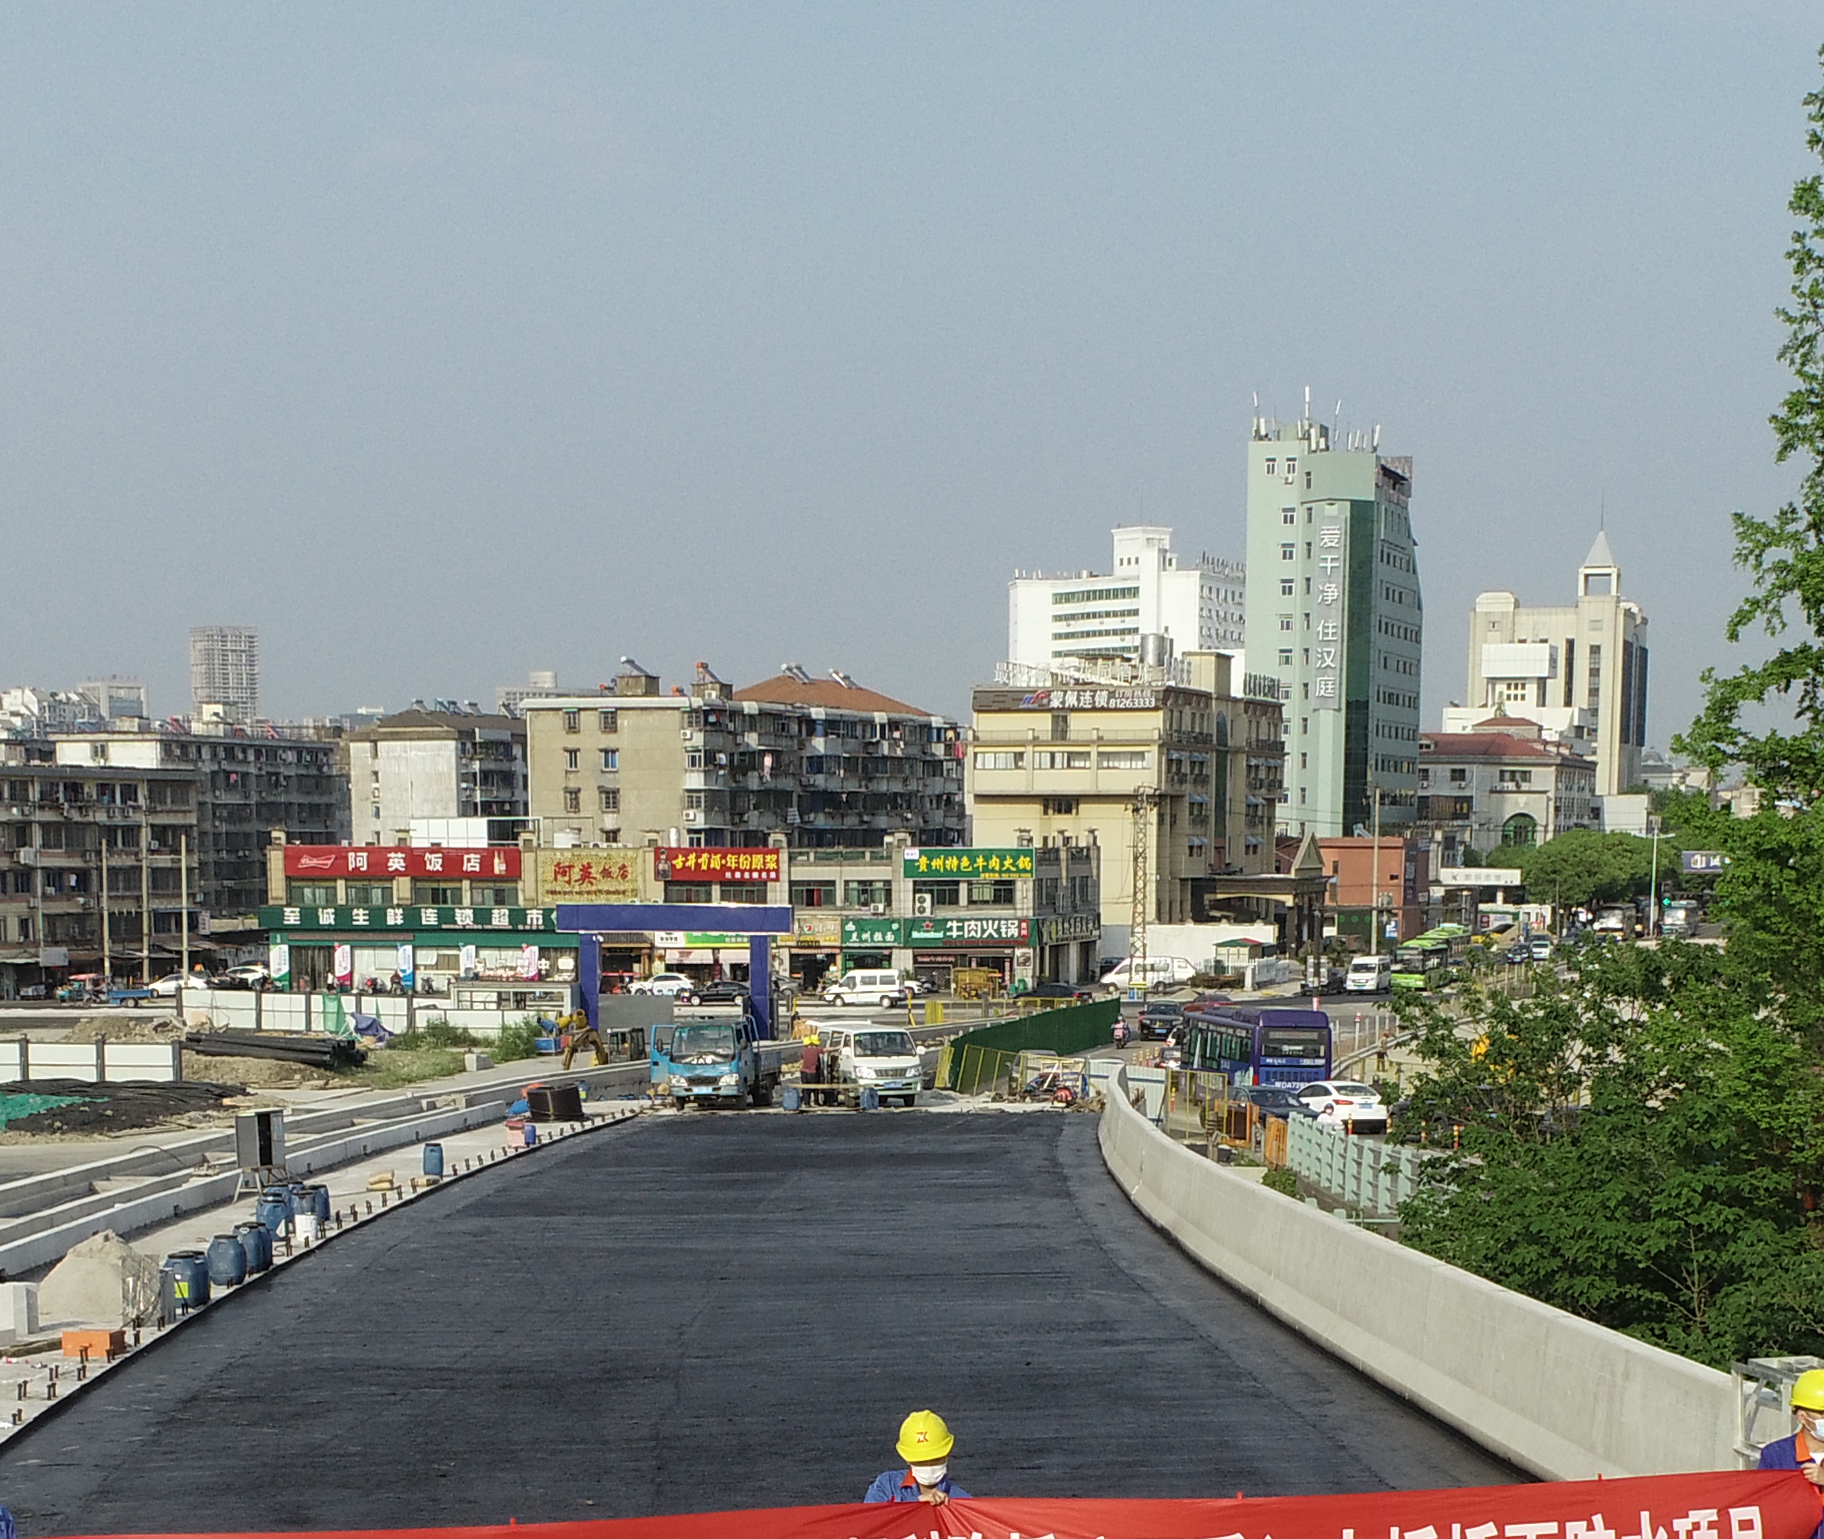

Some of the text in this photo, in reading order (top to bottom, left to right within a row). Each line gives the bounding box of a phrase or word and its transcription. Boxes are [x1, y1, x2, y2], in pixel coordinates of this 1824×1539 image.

[1315, 525, 1341, 697] 爱干净 住汉庭
[348, 851, 481, 872] 阿英饭店
[554, 862, 629, 887] 阿英饭店
[282, 907, 544, 926] 至诚生鲜连锁超市
[946, 920, 1019, 939] 牛肉火锅
